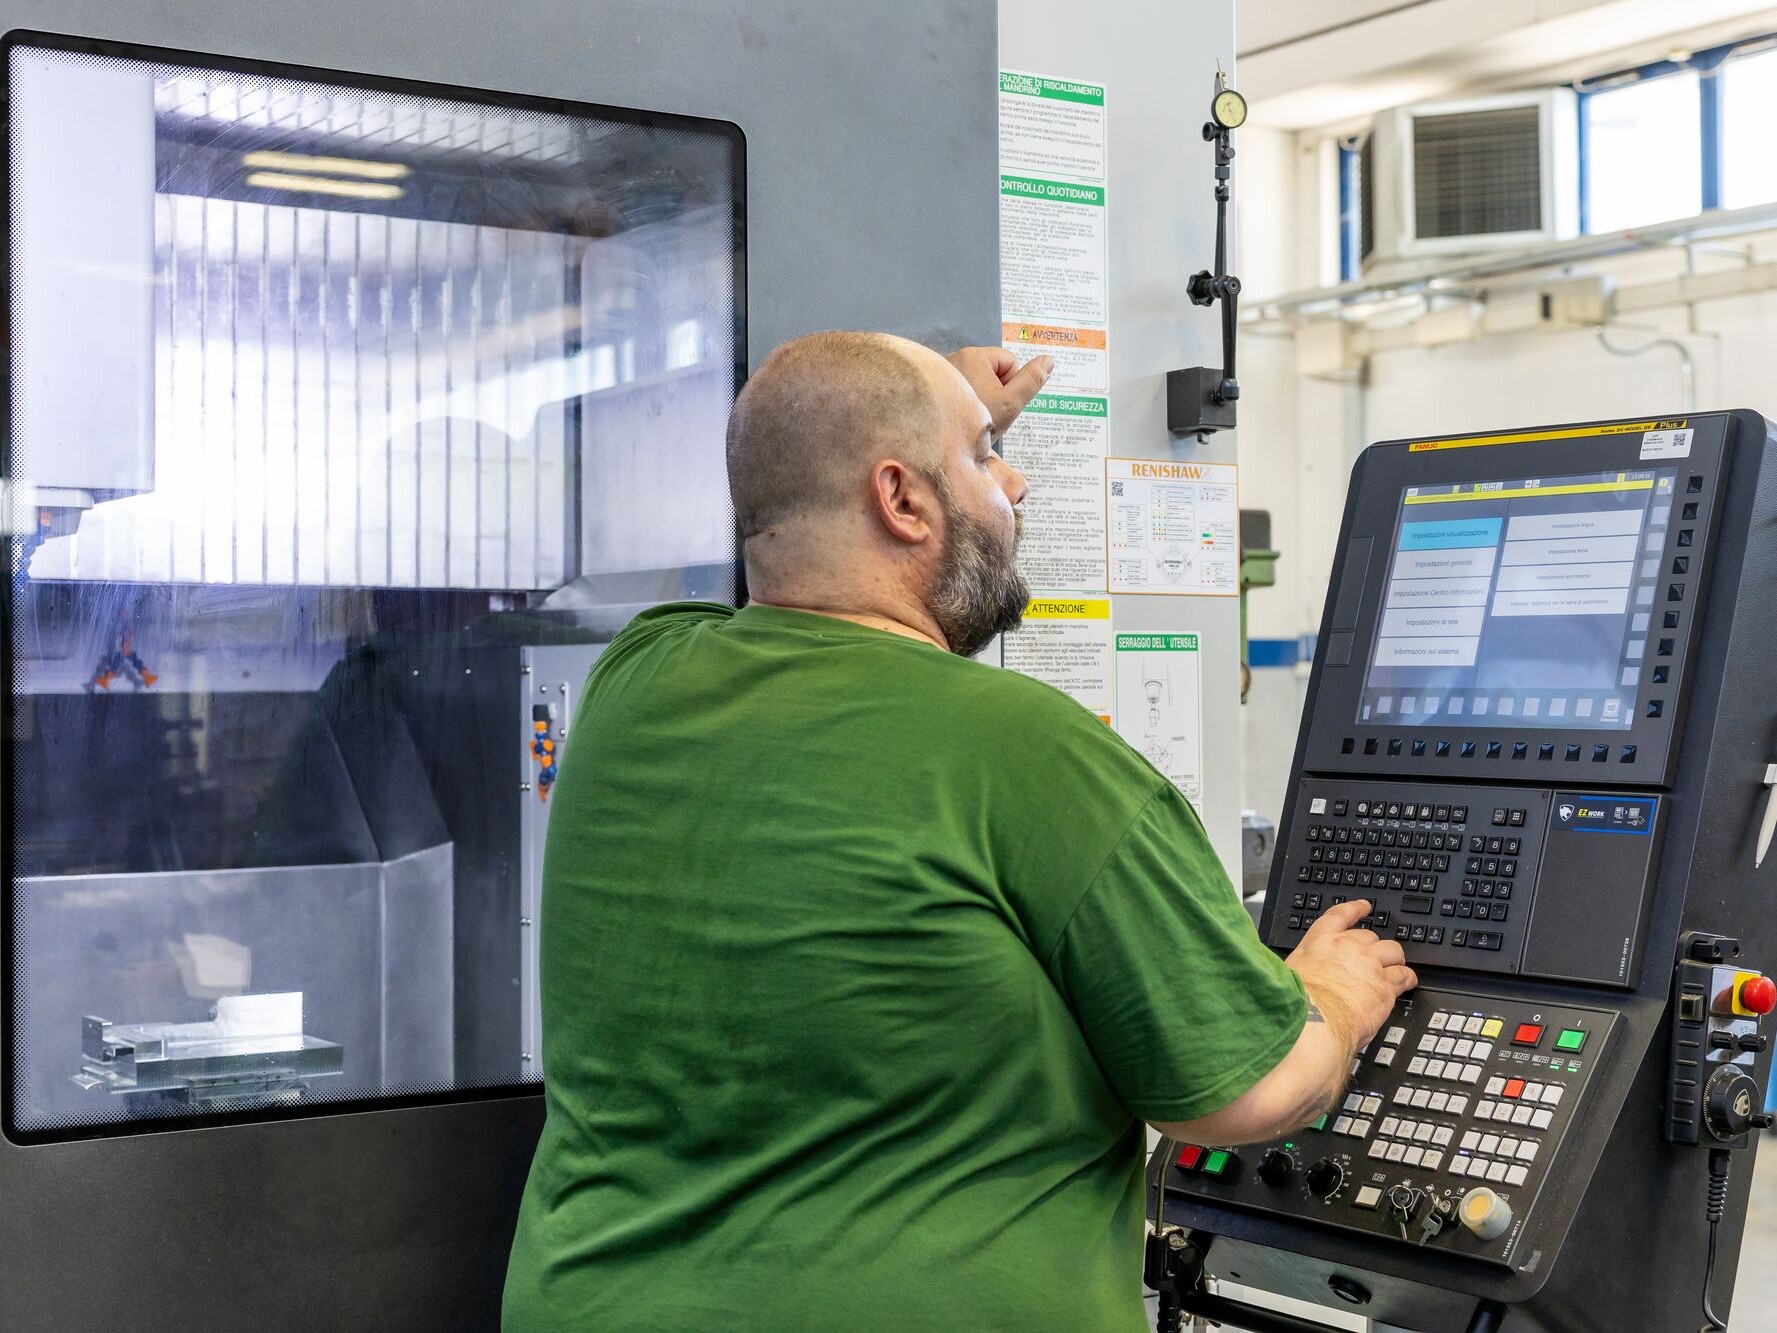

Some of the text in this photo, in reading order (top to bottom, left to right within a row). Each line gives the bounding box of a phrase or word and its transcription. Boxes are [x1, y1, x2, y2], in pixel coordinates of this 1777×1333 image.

[999, 74, 1034, 87] ERAZIONE
[1035, 79, 1042, 88] DI
[1044, 80, 1102, 96] RISCALDAMENTO
[1004, 82, 1040, 96] MANDRINO
[1000, 180, 1098, 200] ONTROLLO QUOTIDIANO
[1032, 330, 1078, 342] AVVERTENZA
[1049, 400, 1057, 408] DI
[1060, 401, 1104, 412] SICUREZZA
[1414, 442, 1438, 450] FANUC
[1132, 464, 1202, 479] RENISHAW
[1393, 590, 1429, 598] Impostazione
[1032, 604, 1085, 613] ATTENZIONE
[1406, 618, 1440, 626] Impostazioni
[1118, 637, 1151, 648] SERRAGGIO
[1170, 637, 1196, 648] UTENSILE
